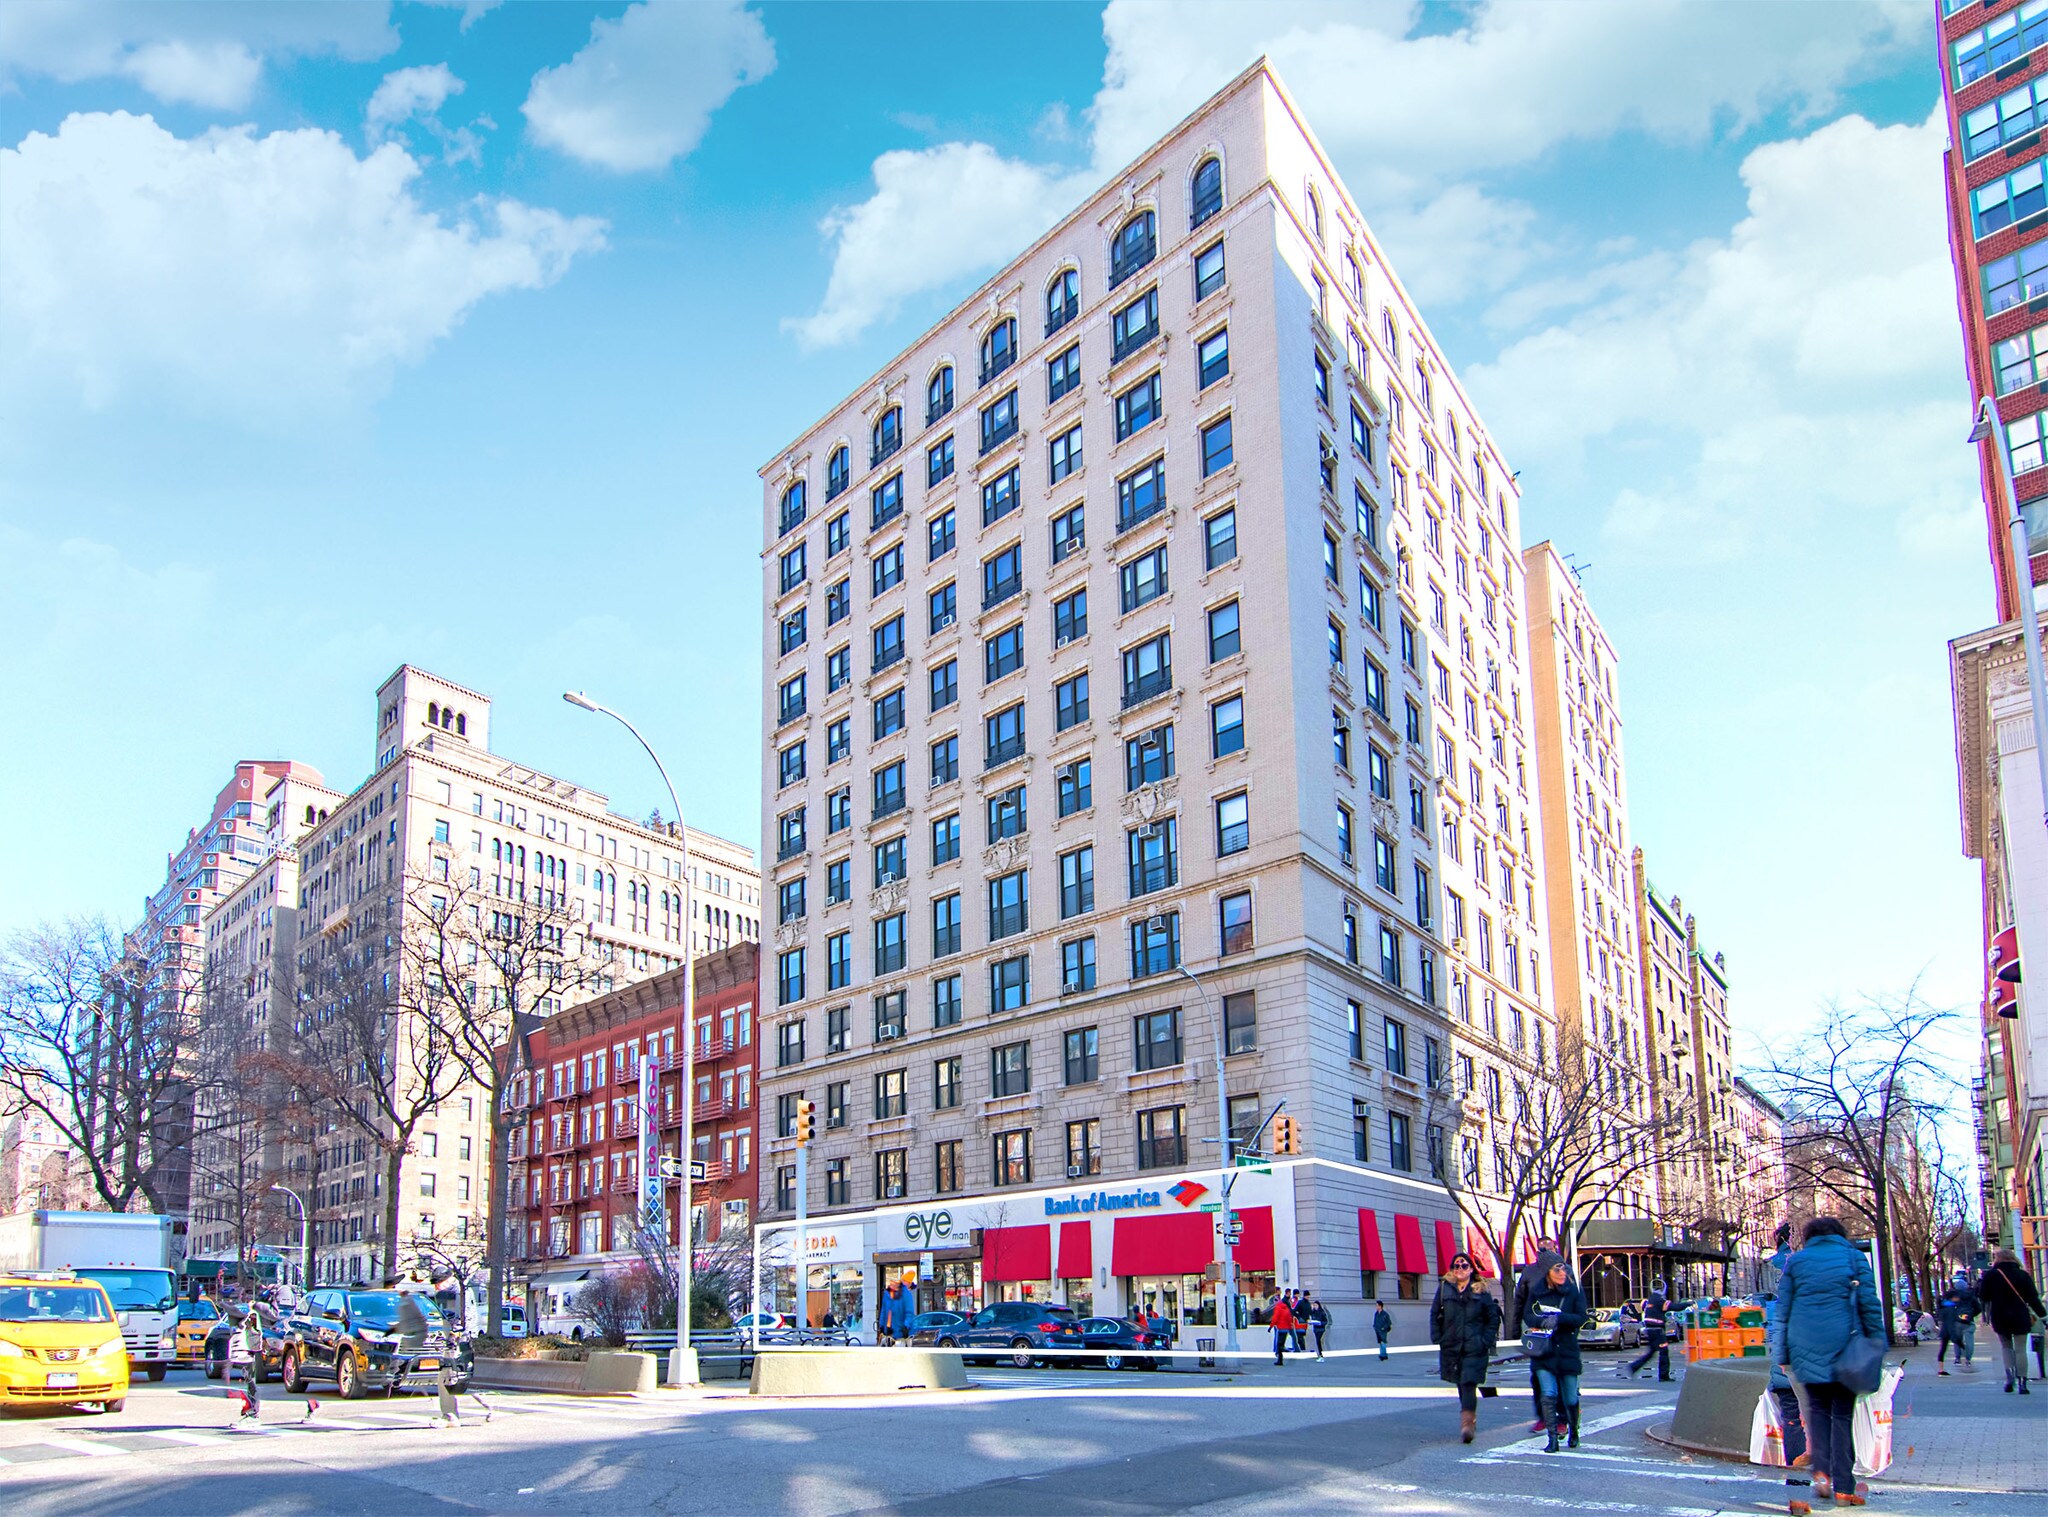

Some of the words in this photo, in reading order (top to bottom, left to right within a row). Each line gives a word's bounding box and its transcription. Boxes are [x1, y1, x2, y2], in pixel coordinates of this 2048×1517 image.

[648, 1064, 658, 1135] TOWN
[1044, 1194, 1080, 1216] Bank
[1081, 1192, 1097, 1213] of
[1097, 1188, 1161, 1211] America
[904, 1209, 953, 1249] eye
